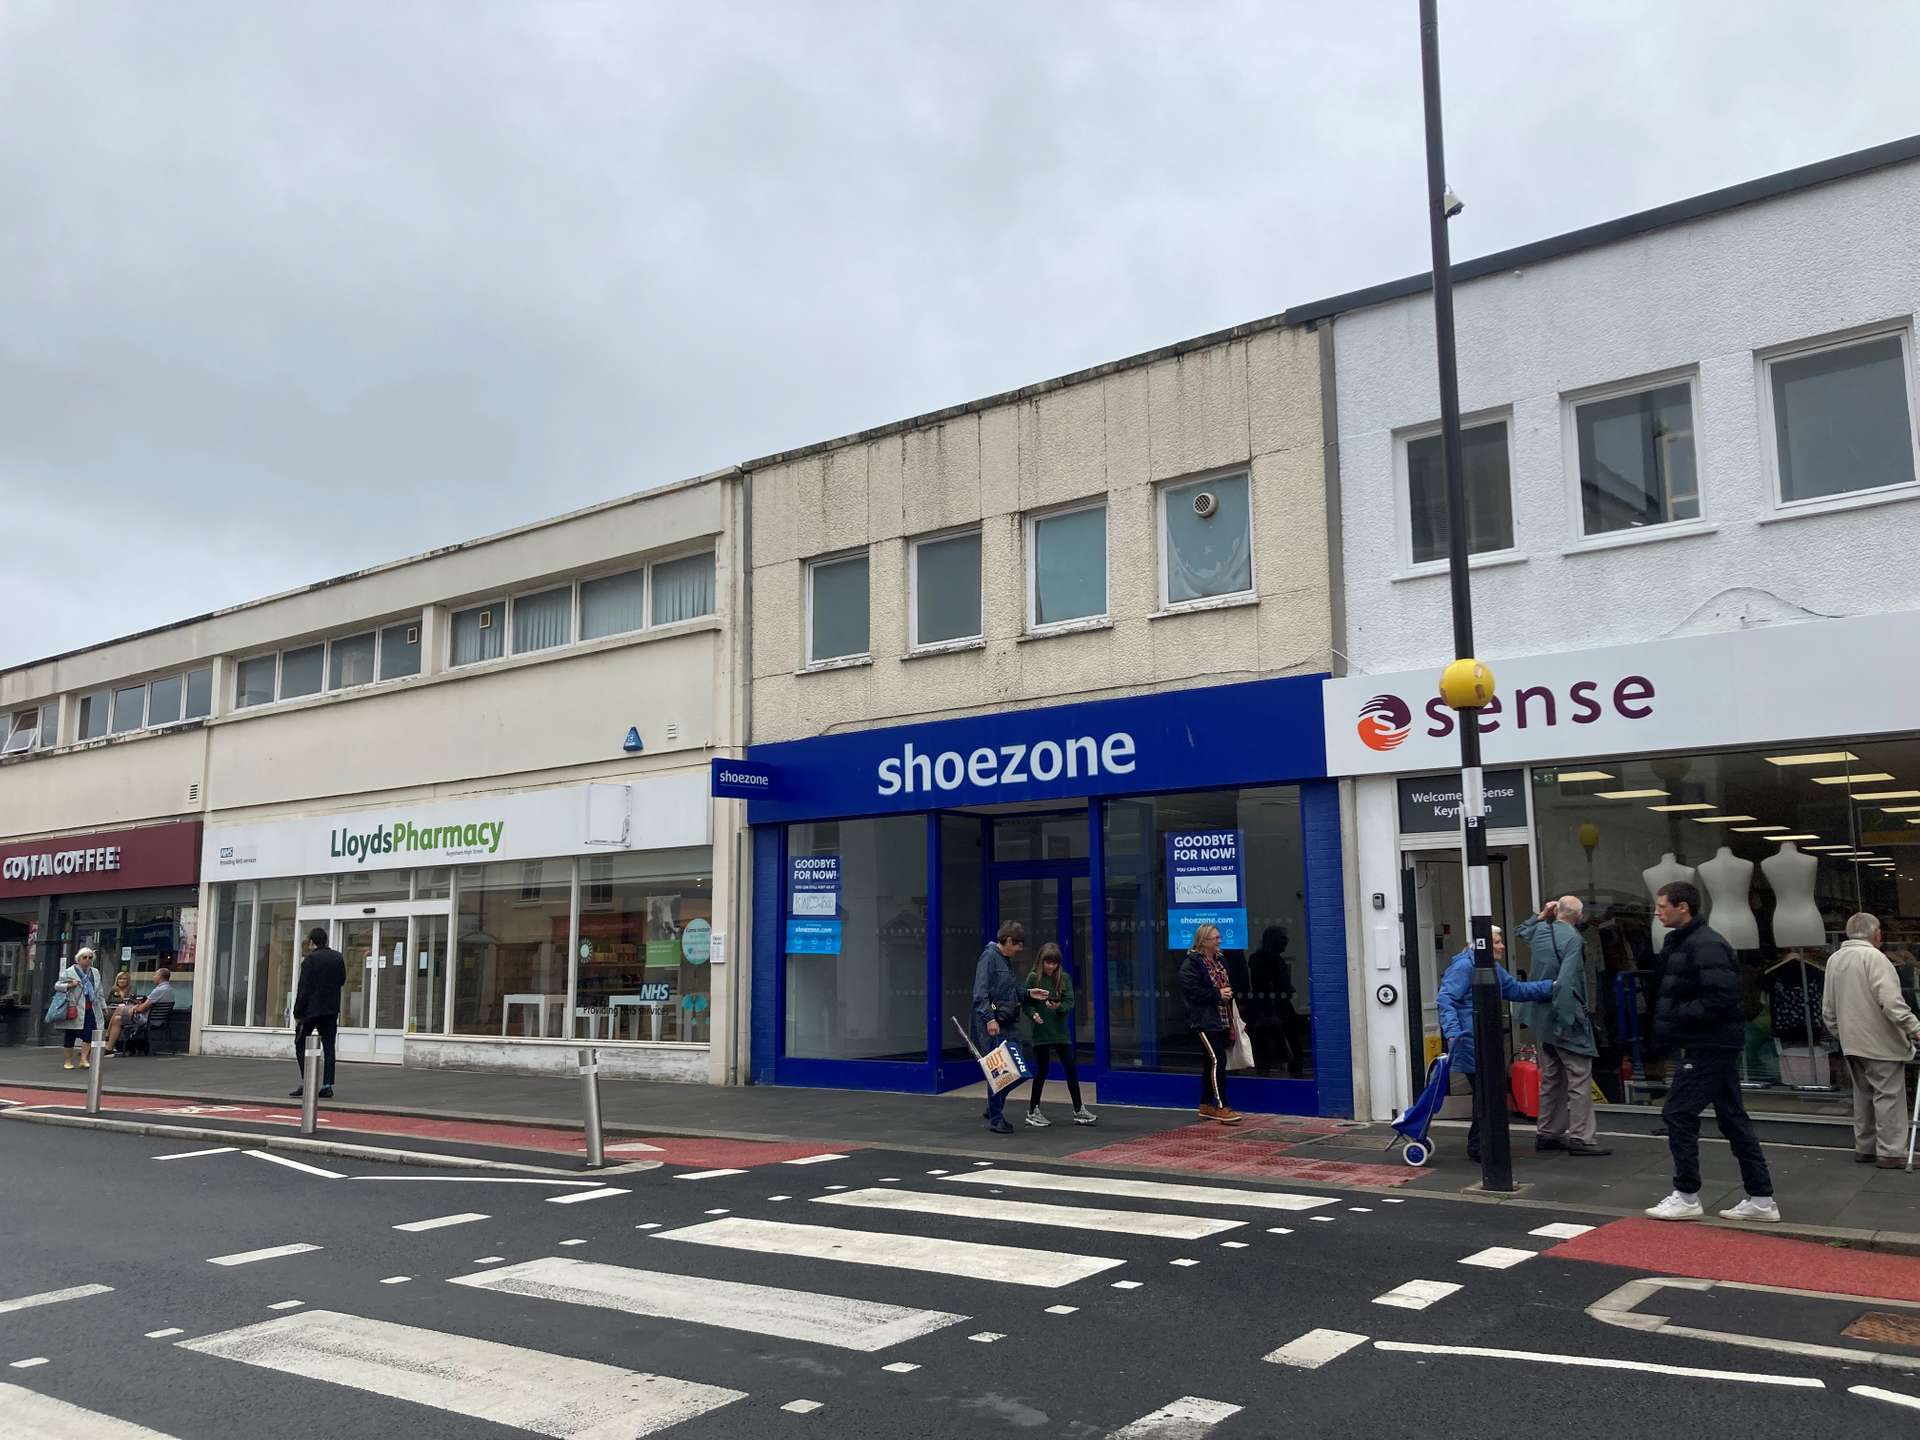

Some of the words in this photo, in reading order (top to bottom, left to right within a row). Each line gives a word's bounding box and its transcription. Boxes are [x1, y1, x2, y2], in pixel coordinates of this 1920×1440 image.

[1425, 675, 1655, 738] sense
[878, 732, 1135, 795] shoezone
[720, 771, 768, 785] shoezone
[1412, 792, 1462, 803] Welcome
[1480, 788, 1514, 798] Sense
[1434, 804, 1492, 818] Keynm
[331, 821, 504, 863] LloydsPharmacy
[1174, 834, 1234, 847] GOODBYE
[1174, 850, 1198, 861] FOR
[1201, 848, 1236, 860] NOW!
[3, 854, 53, 880] COSTA
[54, 847, 120, 875] COFFEE
[795, 859, 837, 869] GOODBYE
[794, 871, 811, 880] FOR
[812, 870, 837, 880] NOW!
[1180, 916, 1234, 924] shoezone.com
[641, 984, 669, 1000] NHS
[986, 1050, 1004, 1070] OUT
[1010, 1047, 1027, 1073] RNLI
